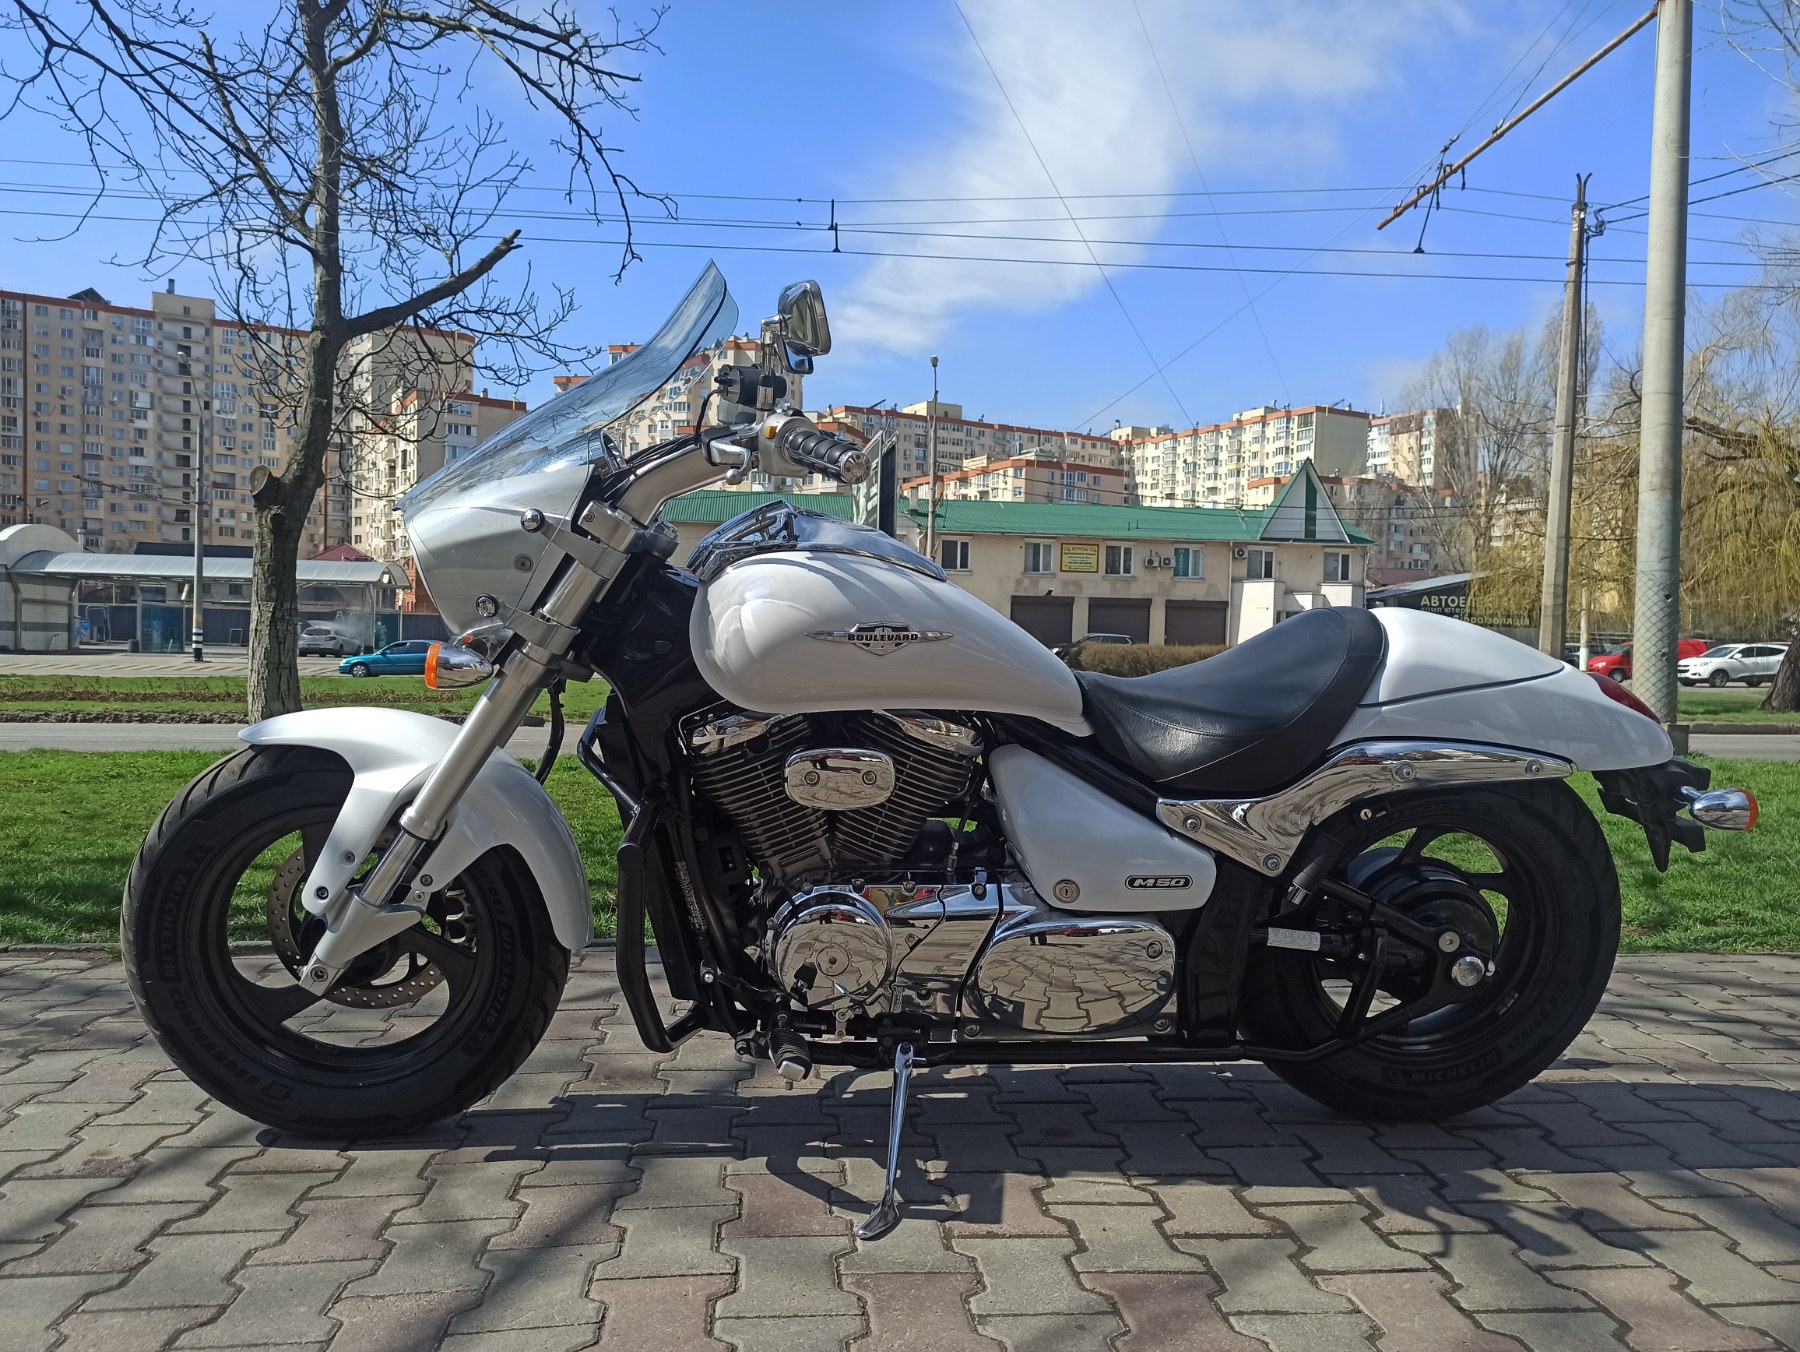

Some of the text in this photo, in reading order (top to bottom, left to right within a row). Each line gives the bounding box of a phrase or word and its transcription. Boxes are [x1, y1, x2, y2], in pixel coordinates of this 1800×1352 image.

[847, 633, 919, 642] BOULEVARD
[1133, 878, 1186, 887] M50
[159, 872, 189, 978] MICHELIN
[485, 928, 513, 1027] MICHELIN
[168, 988, 260, 1085] COMMANDER
[1410, 1052, 1500, 1083] MICHELIN
